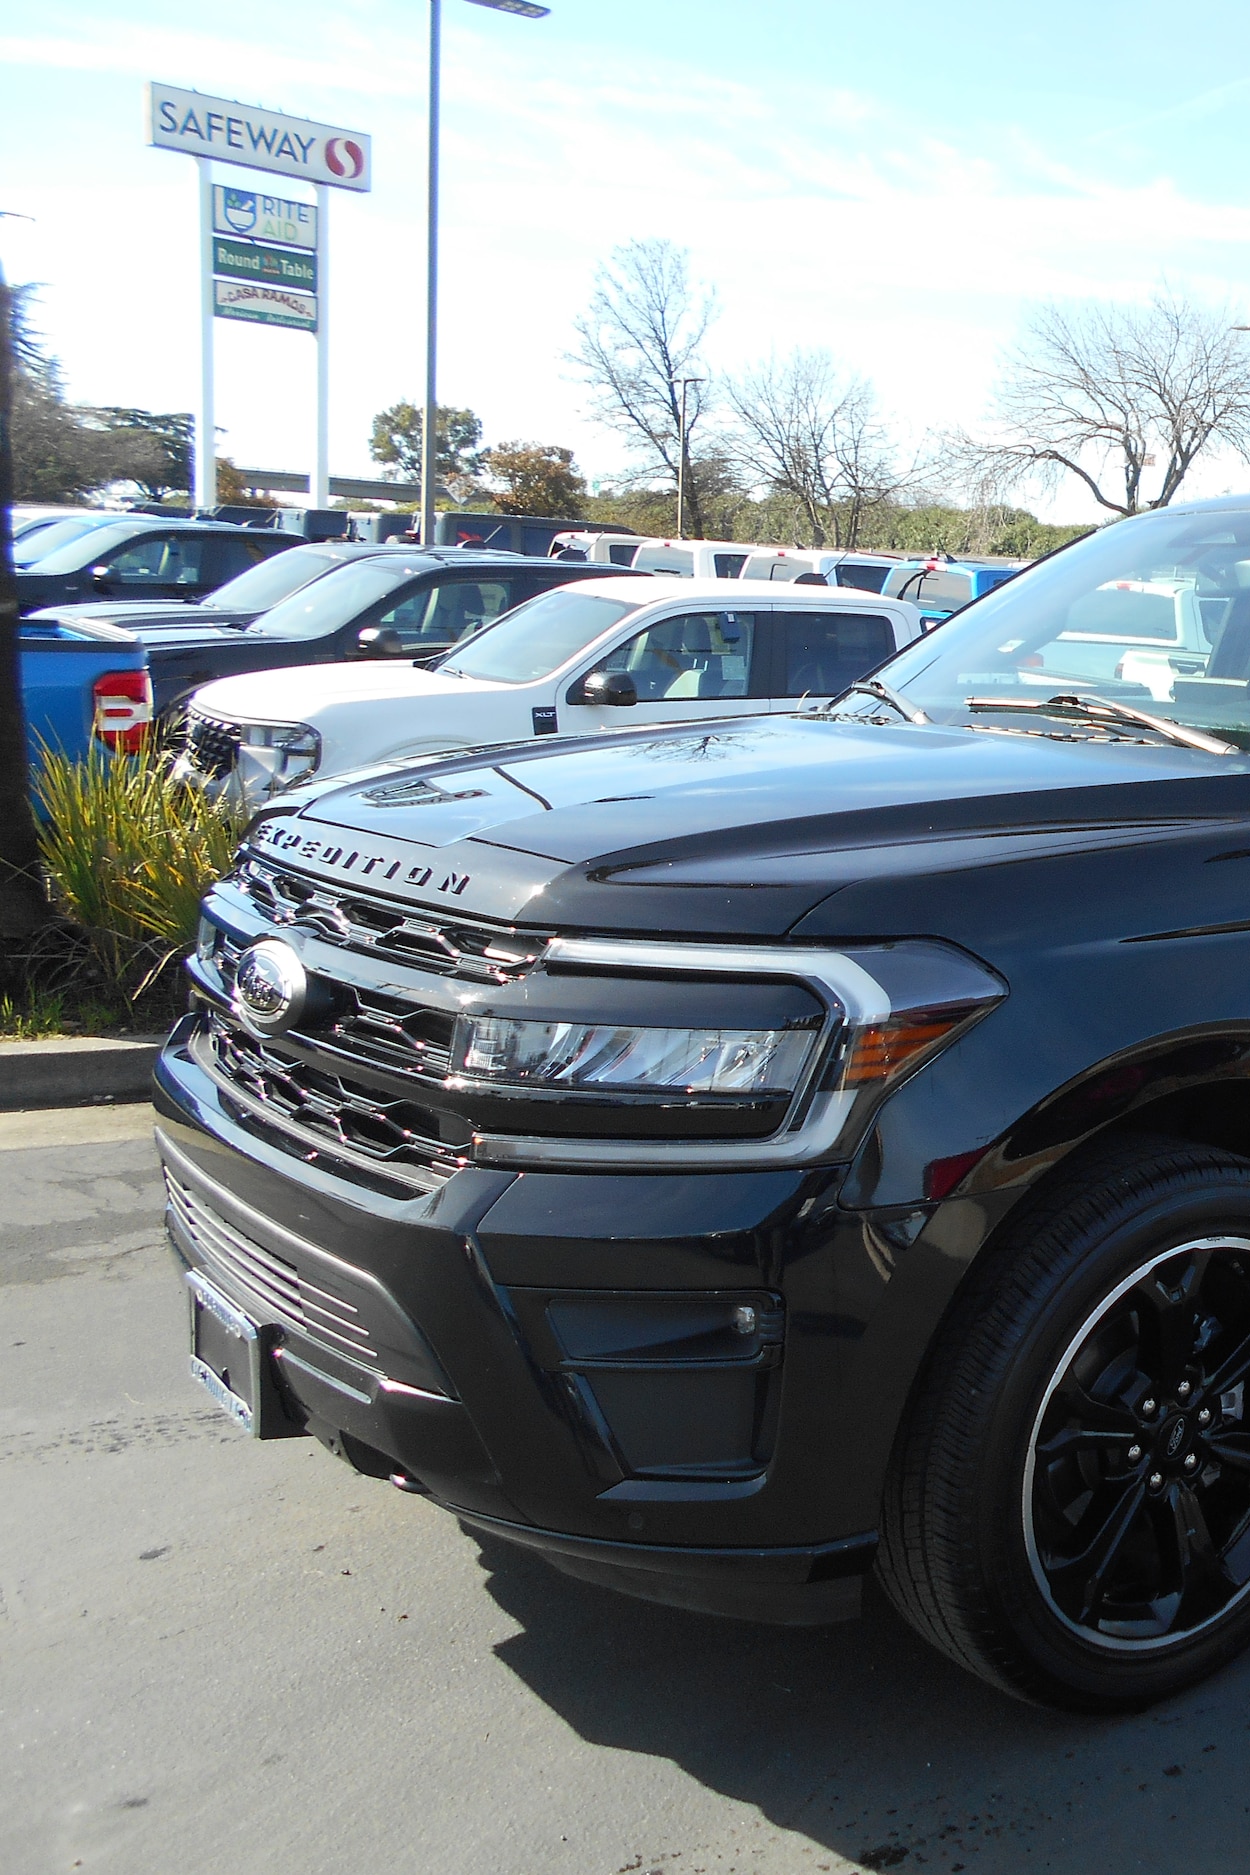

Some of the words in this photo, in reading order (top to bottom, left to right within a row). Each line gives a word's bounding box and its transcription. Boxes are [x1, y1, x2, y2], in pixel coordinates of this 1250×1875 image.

[159, 101, 317, 165] SAFEWAY
[262, 197, 310, 223] RITE
[262, 219, 298, 241] AID
[217, 247, 260, 270] Round
[280, 259, 314, 280] Table
[227, 287, 260, 303] CASA
[261, 288, 306, 315] RAMOS
[256, 823, 472, 897] EXPEDITION
